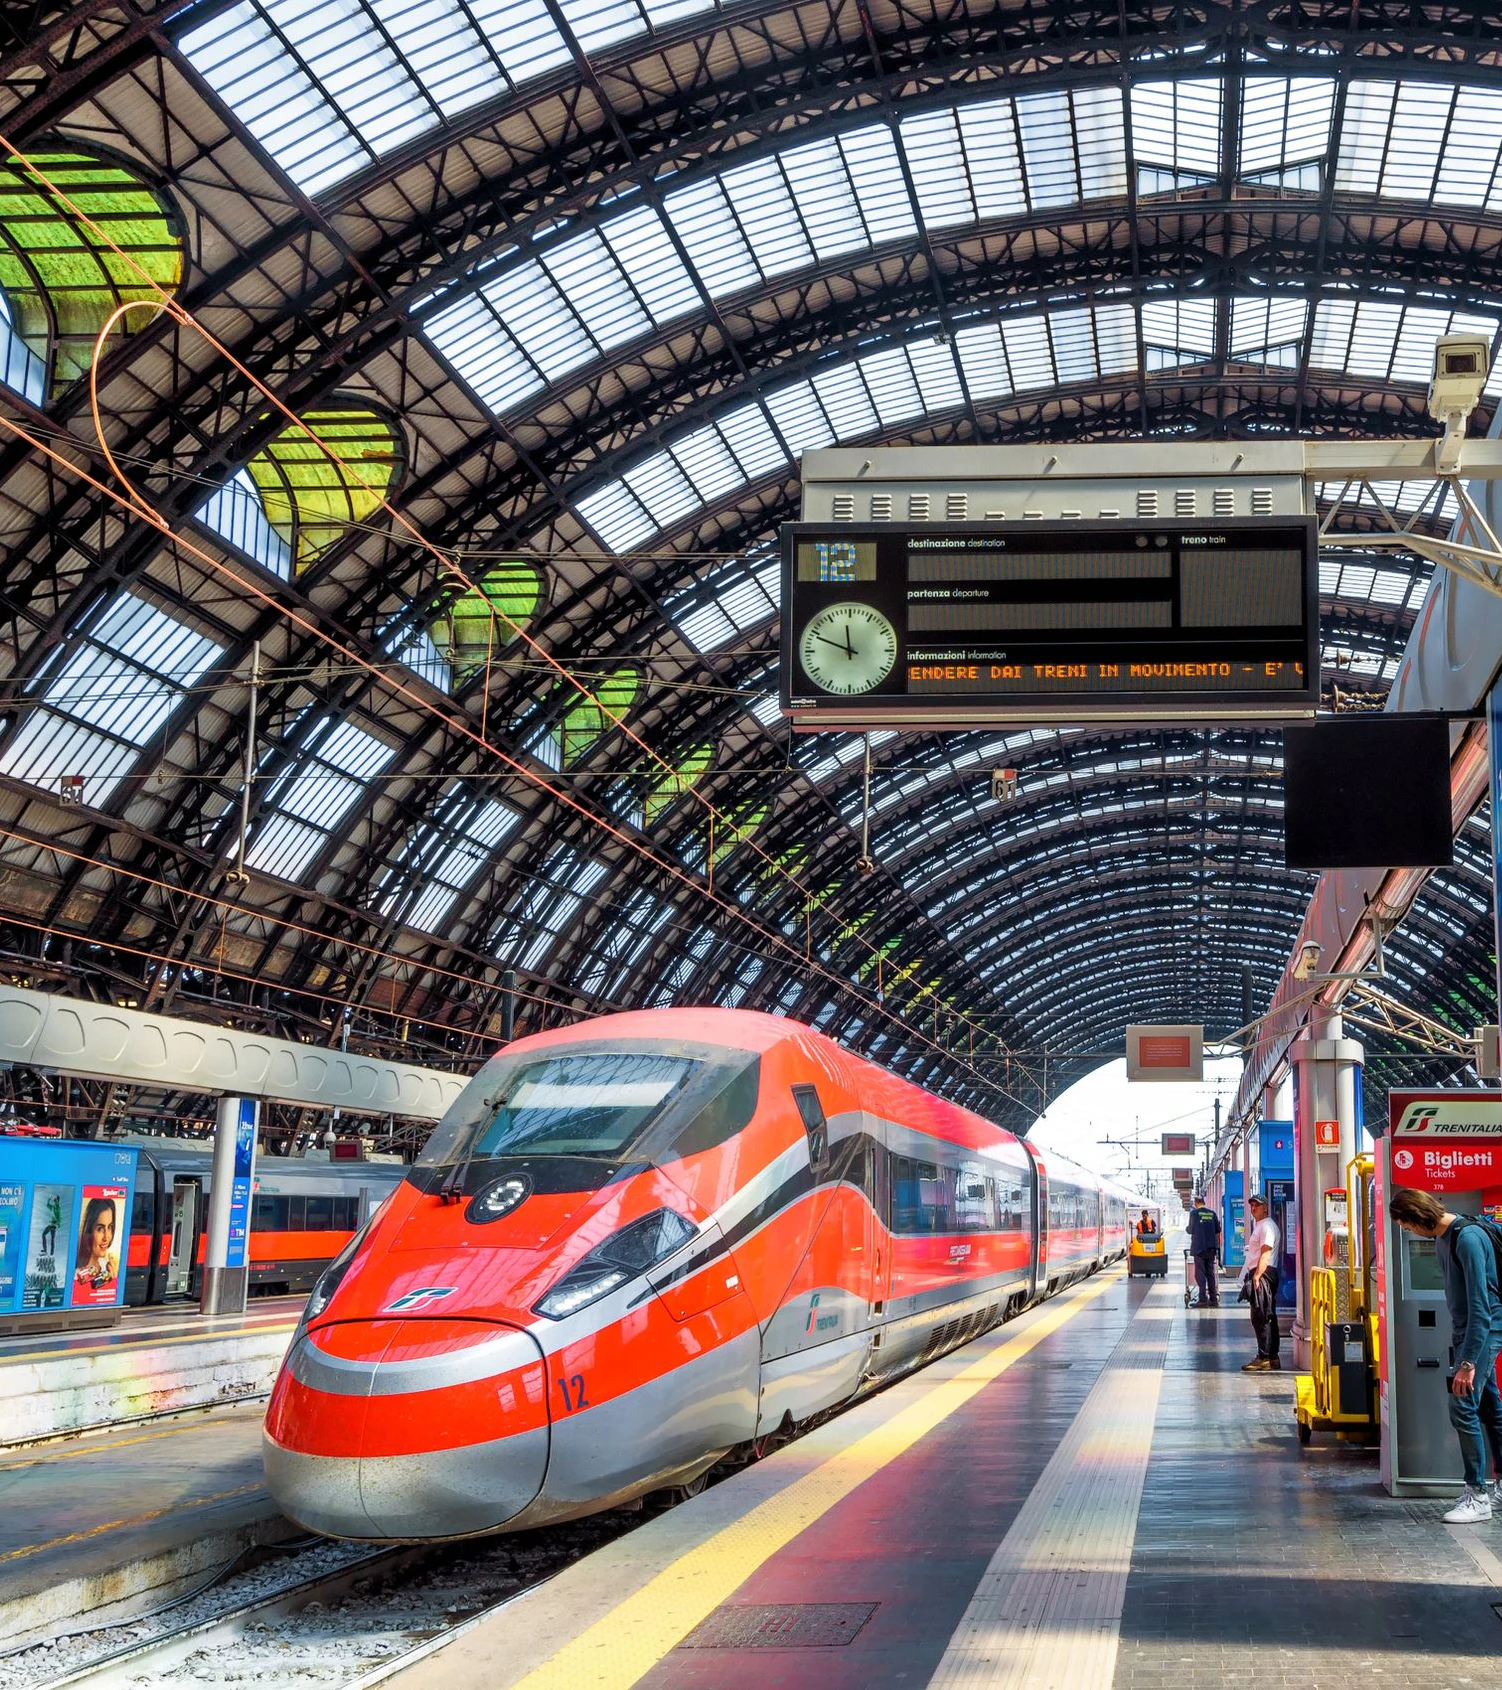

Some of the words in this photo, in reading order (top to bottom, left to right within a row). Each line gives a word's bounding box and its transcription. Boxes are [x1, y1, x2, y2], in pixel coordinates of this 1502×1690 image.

[907, 538, 966, 548] destinazione
[967, 538, 1006, 547] destination
[1181, 535, 1207, 545] treno
[1209, 535, 1226, 544] train
[815, 543, 856, 581] 12
[907, 588, 950, 600] partenza
[952, 588, 989, 599] departure
[907, 650, 966, 661] informazioni
[968, 649, 1007, 660] information
[908, 666, 978, 680] ENDERE
[990, 665, 1022, 679] DAI
[1034, 664, 1087, 678] TRENI
[1099, 664, 1119, 678] IN
[1130, 663, 1231, 677] MOVIMENTO
[1434, 1124, 1502, 1133] TRENITALIA
[1424, 1150, 1493, 1169] Biglietti
[1425, 1168, 1456, 1178] Tickets
[557, 1373, 589, 1412] 12
